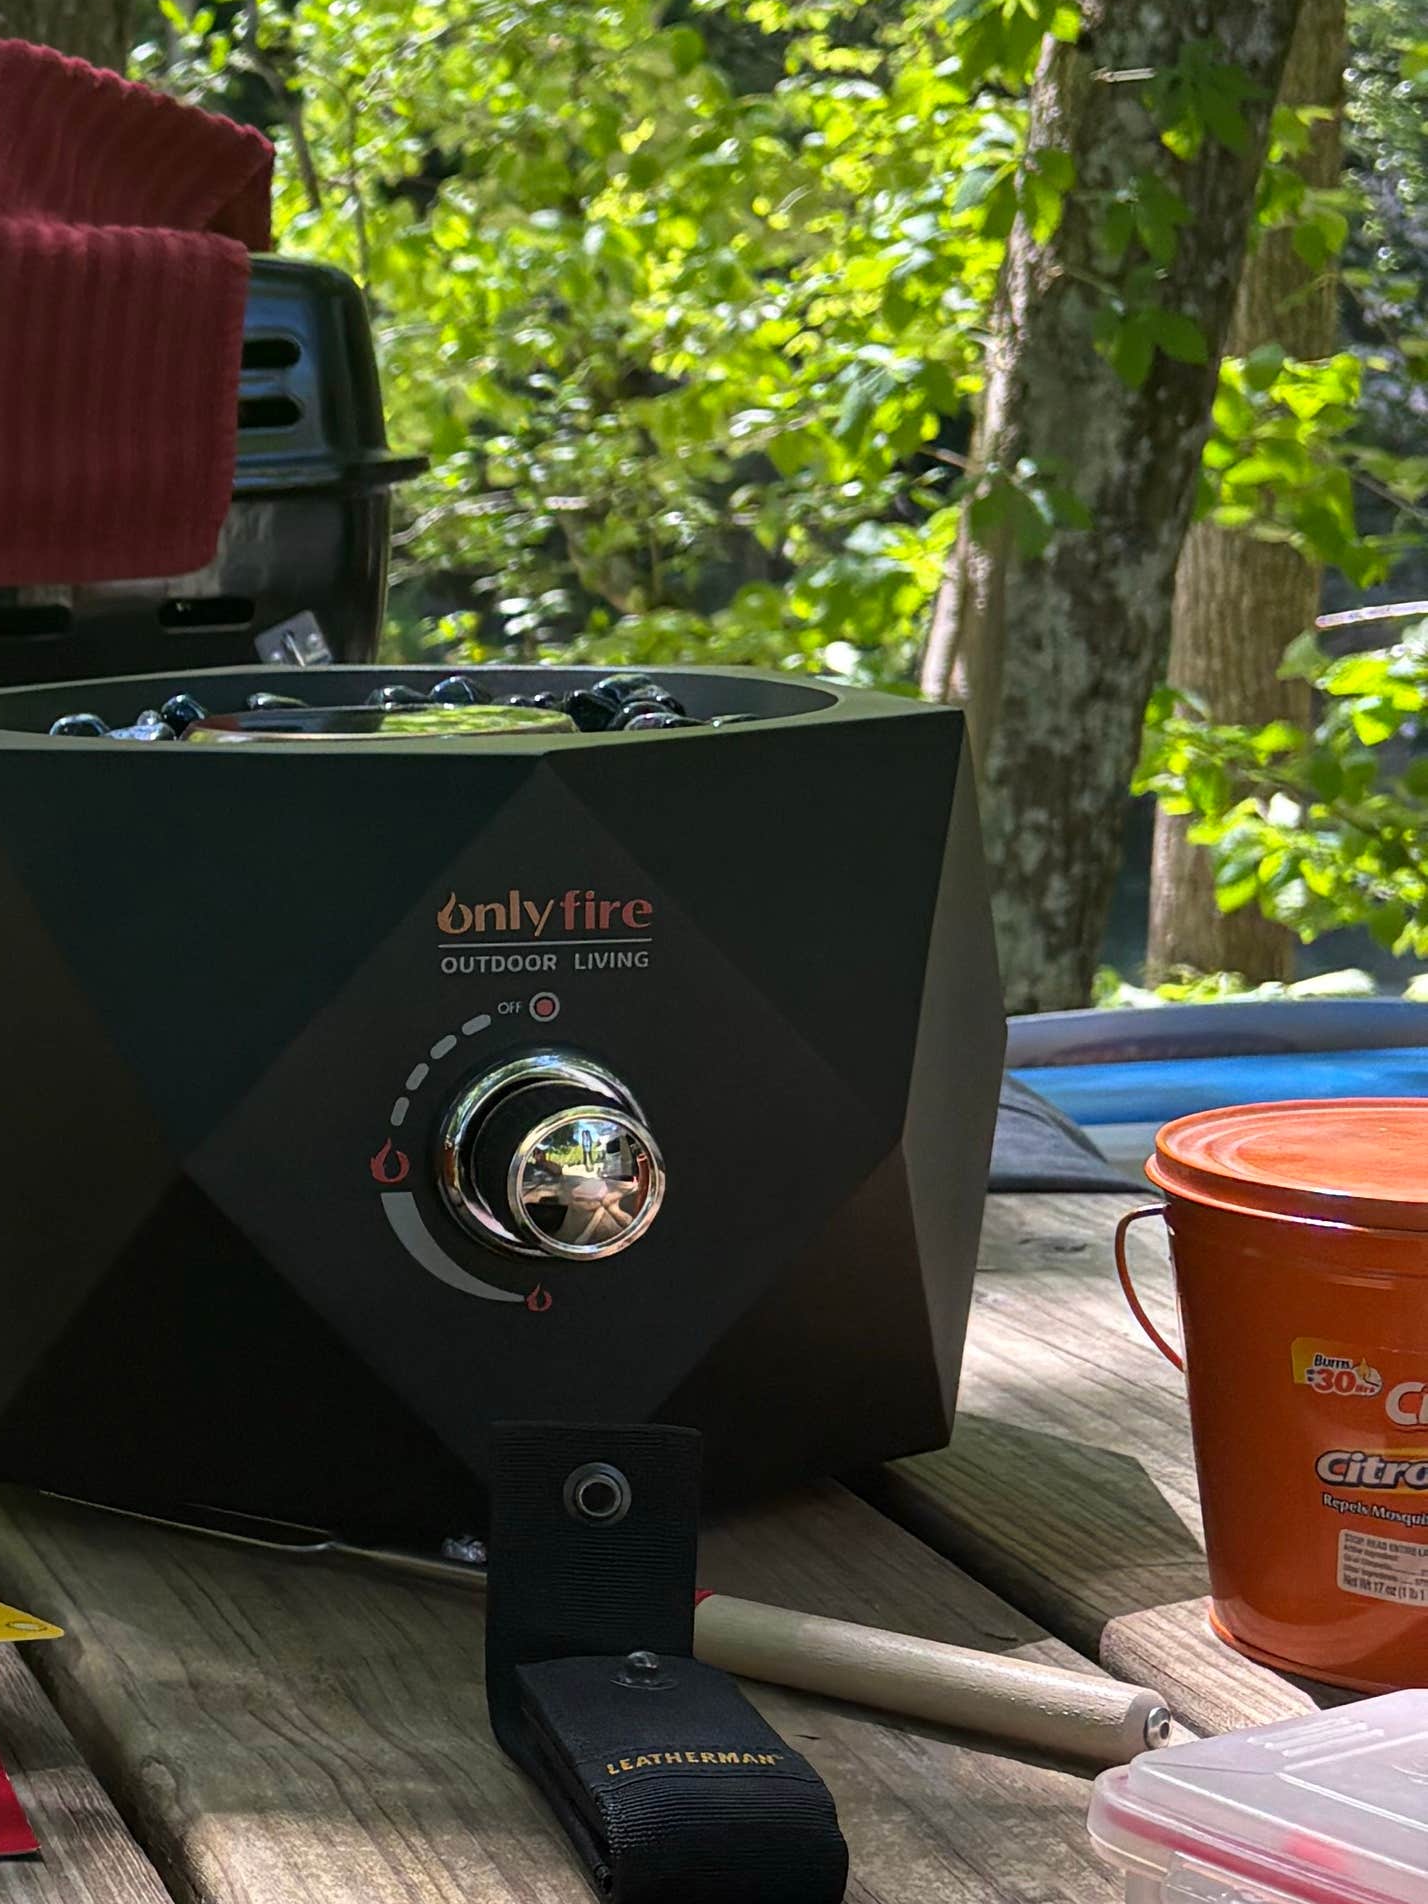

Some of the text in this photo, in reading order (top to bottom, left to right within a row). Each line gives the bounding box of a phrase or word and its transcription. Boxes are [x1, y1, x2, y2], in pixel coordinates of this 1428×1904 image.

[440, 950, 649, 975] OUTDOOR LIVING
[497, 1000, 522, 1015] OFF
[1311, 1367, 1357, 1393] 30
[1323, 1492, 1369, 1515] Repels
[605, 1751, 777, 1776] LEATHERMAN
